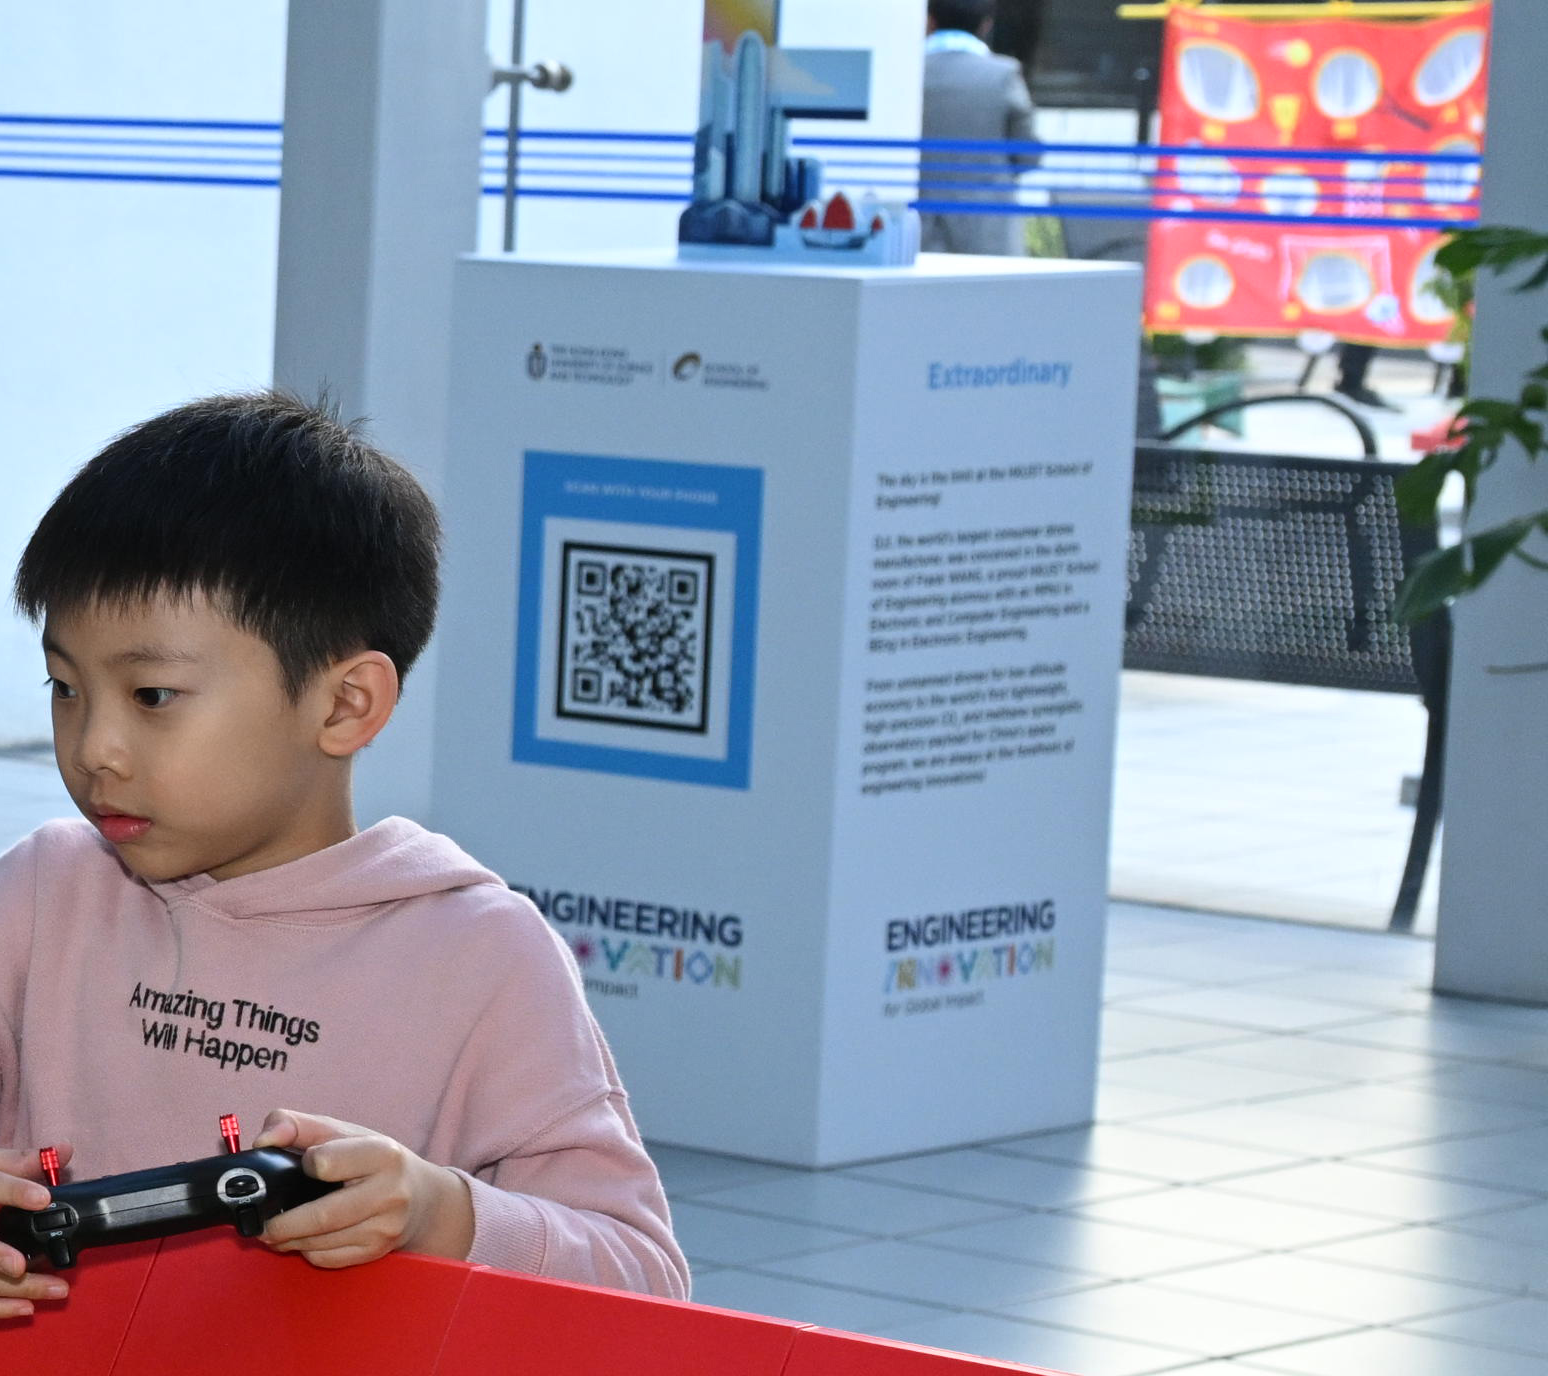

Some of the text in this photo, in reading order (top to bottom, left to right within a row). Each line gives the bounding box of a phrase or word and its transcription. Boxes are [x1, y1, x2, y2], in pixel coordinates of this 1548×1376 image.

[928, 356, 1073, 390] Extraordinary
[885, 898, 1056, 951] ENGINEERING
[129, 982, 320, 1046] Amazing Things
[142, 1018, 288, 1071] Will Happen
